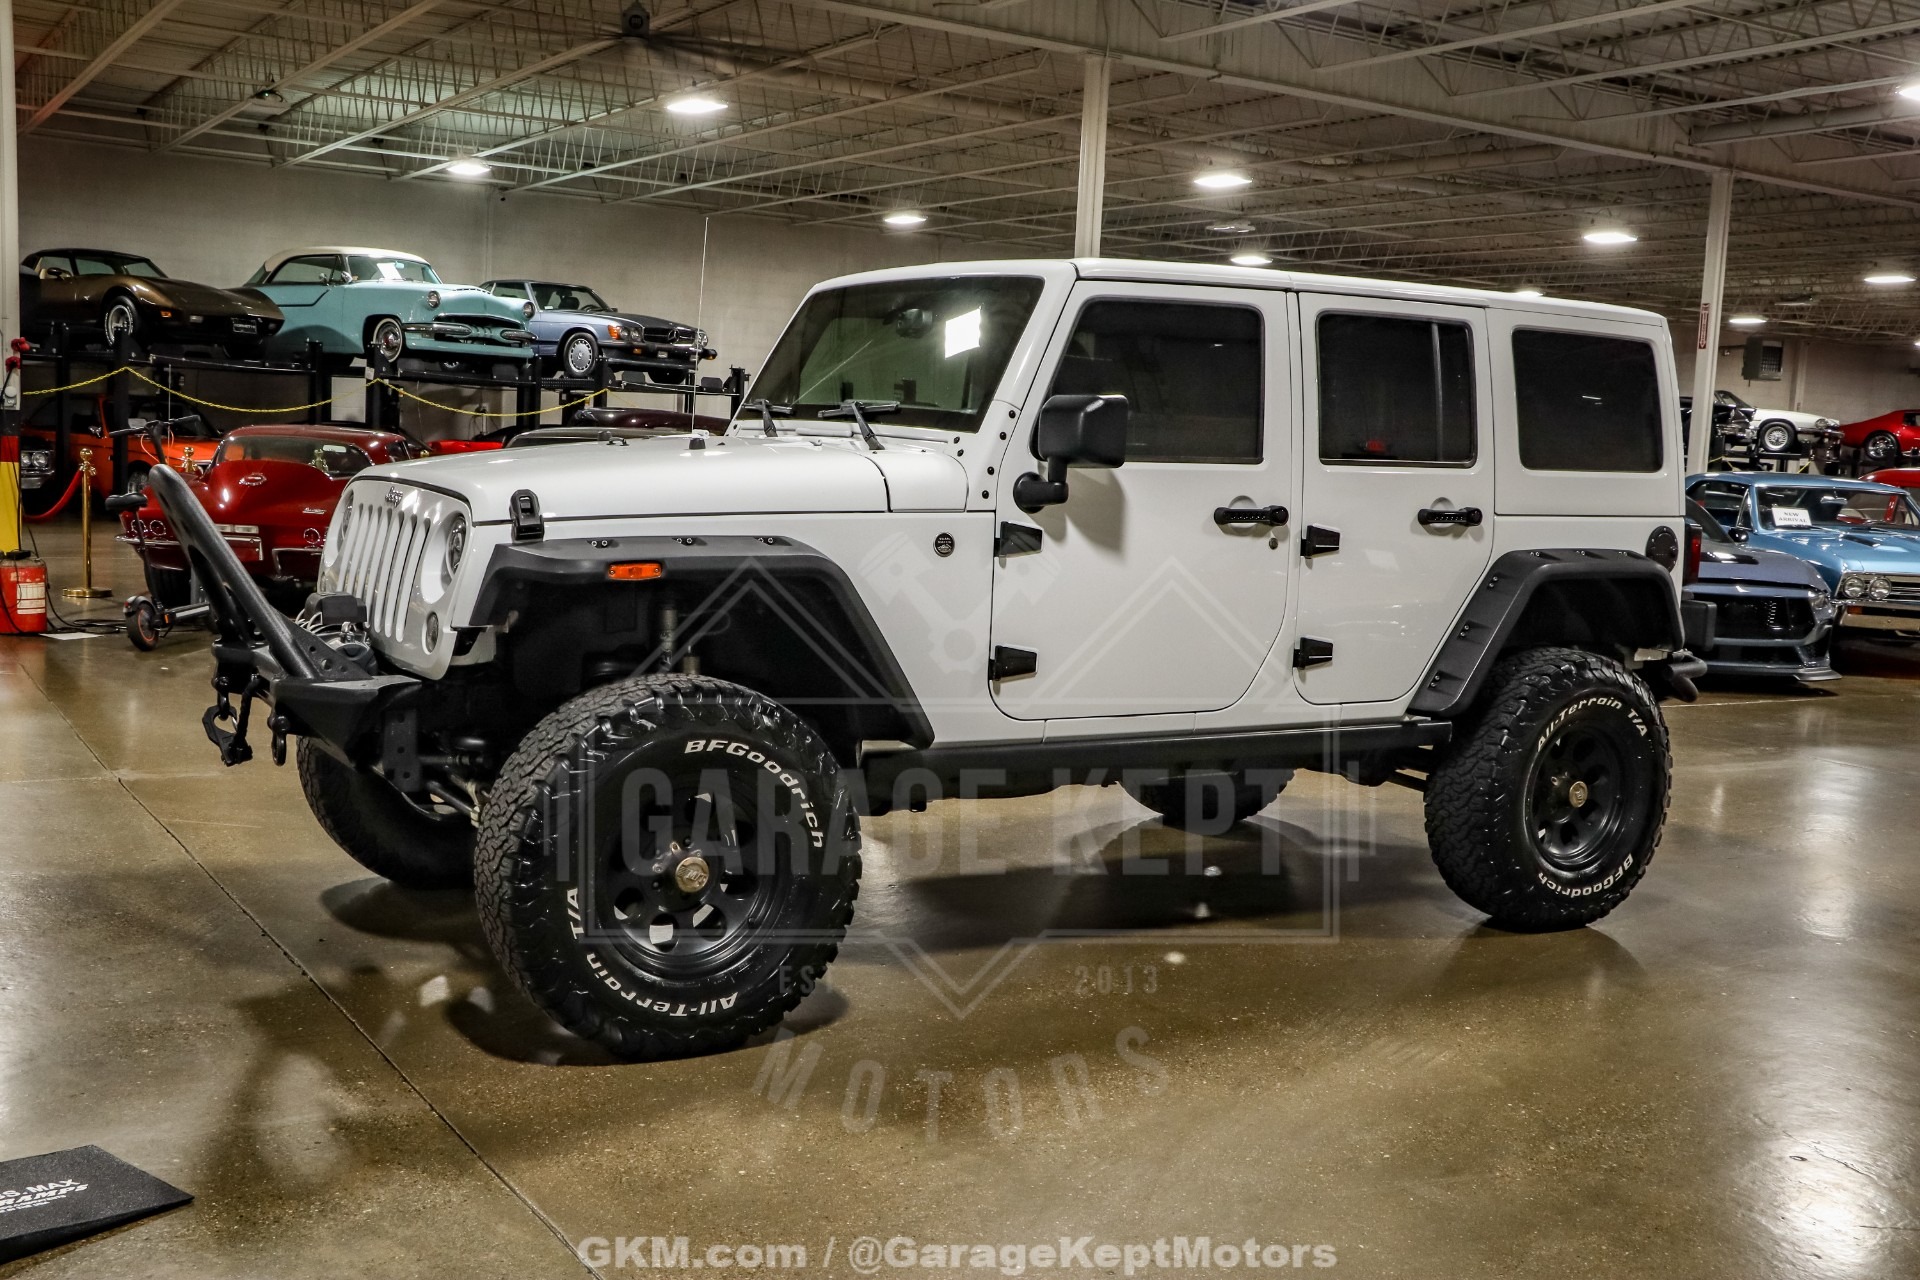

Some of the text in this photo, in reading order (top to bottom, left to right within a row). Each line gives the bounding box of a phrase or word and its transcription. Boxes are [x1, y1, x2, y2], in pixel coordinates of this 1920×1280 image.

[1536, 695, 1649, 753] All-Terrain T/A
[683, 739, 824, 849] BFGoodrich
[1537, 853, 1635, 899] BFGoodrich
[566, 887, 740, 1018] All-Terrain T/A
